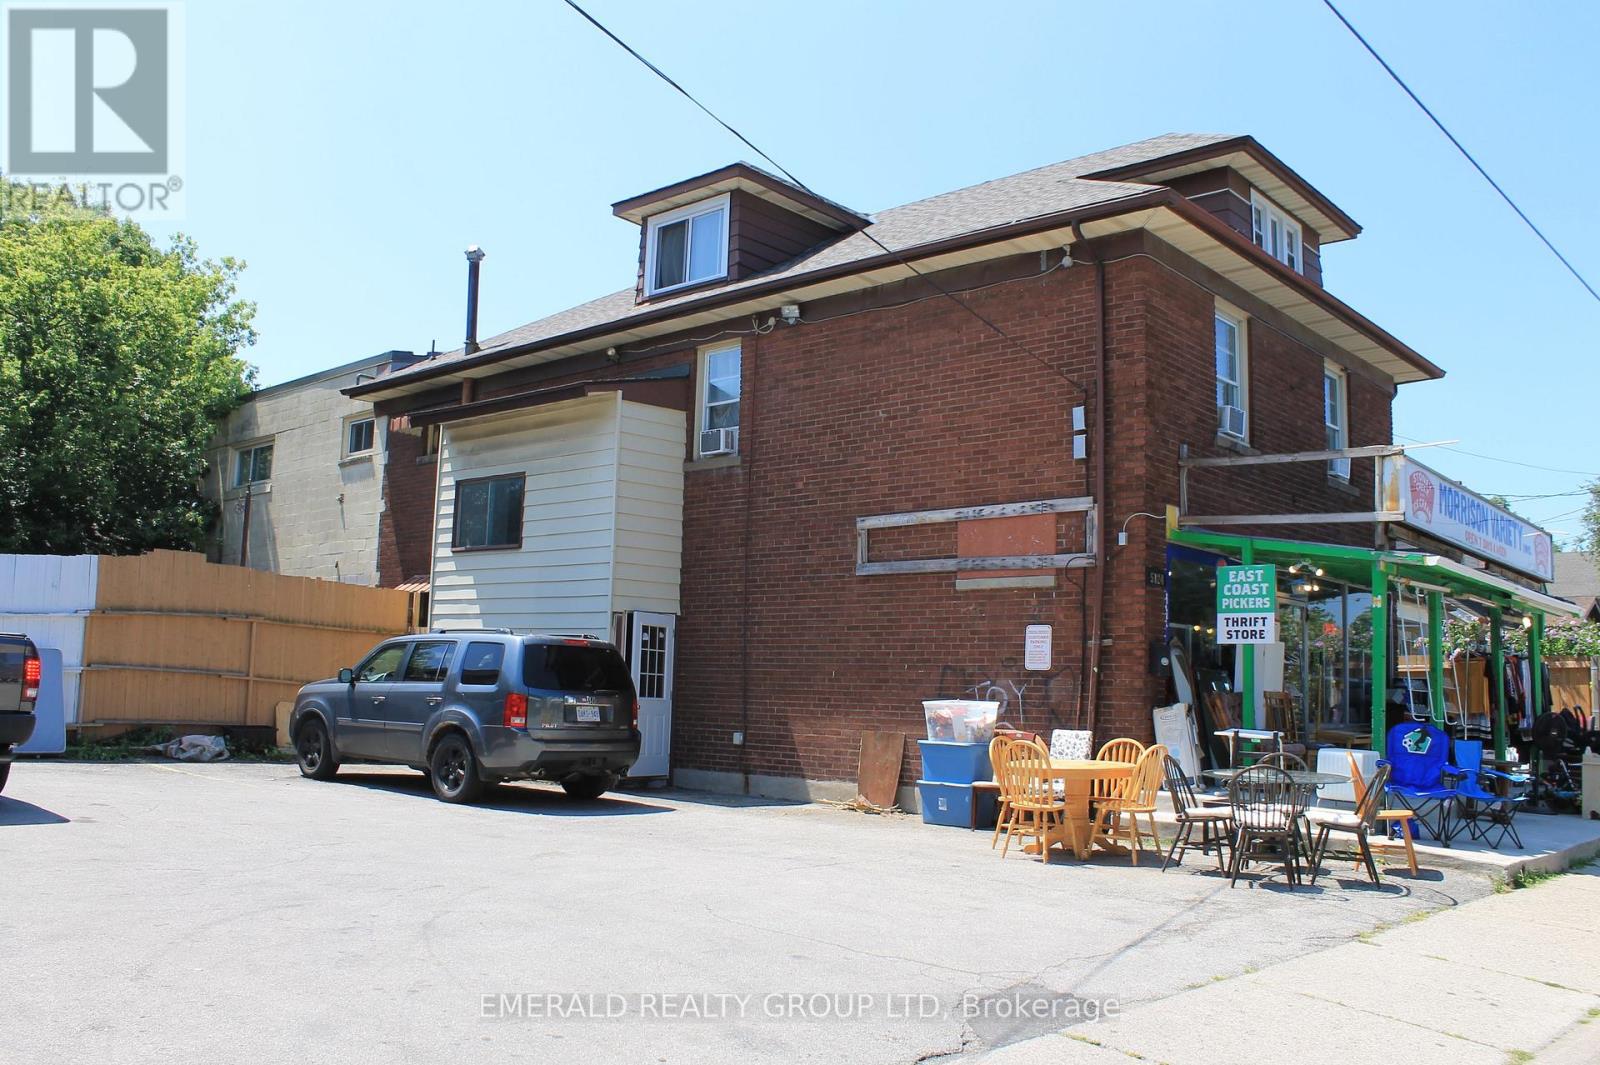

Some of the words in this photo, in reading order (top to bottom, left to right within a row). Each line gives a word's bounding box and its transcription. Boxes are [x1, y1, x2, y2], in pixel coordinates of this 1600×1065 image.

[1439, 483, 1489, 535] MORRISON
[1490, 509, 1523, 551] VARIETY
[1228, 570, 1264, 582] EAST
[1223, 583, 1269, 596] COAST
[1221, 597, 1271, 609] PICKERS
[1224, 617, 1268, 627] THRIFT
[1226, 629, 1266, 640] STORE
